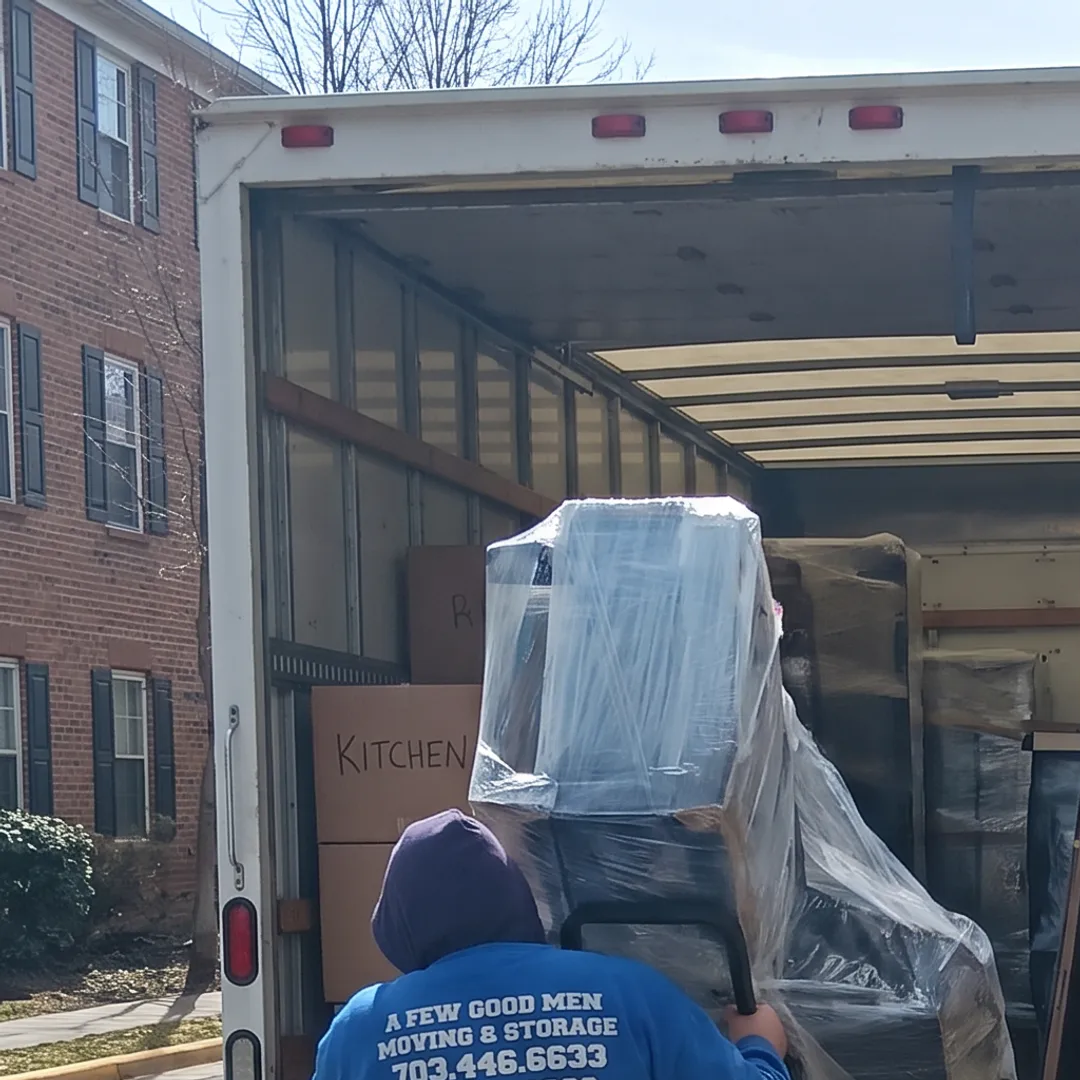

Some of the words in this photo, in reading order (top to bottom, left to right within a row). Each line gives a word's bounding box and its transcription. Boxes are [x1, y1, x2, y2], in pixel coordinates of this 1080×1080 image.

[336, 733, 468, 776] KITCHEN
[385, 1013, 401, 1032] A
[405, 1002, 462, 1028] FEW
[468, 994, 535, 1019] GOOD
[541, 992, 603, 1012] MEN
[377, 1027, 474, 1060] MOVING
[479, 1025, 498, 1044] &
[503, 1017, 619, 1042] STORAGE
